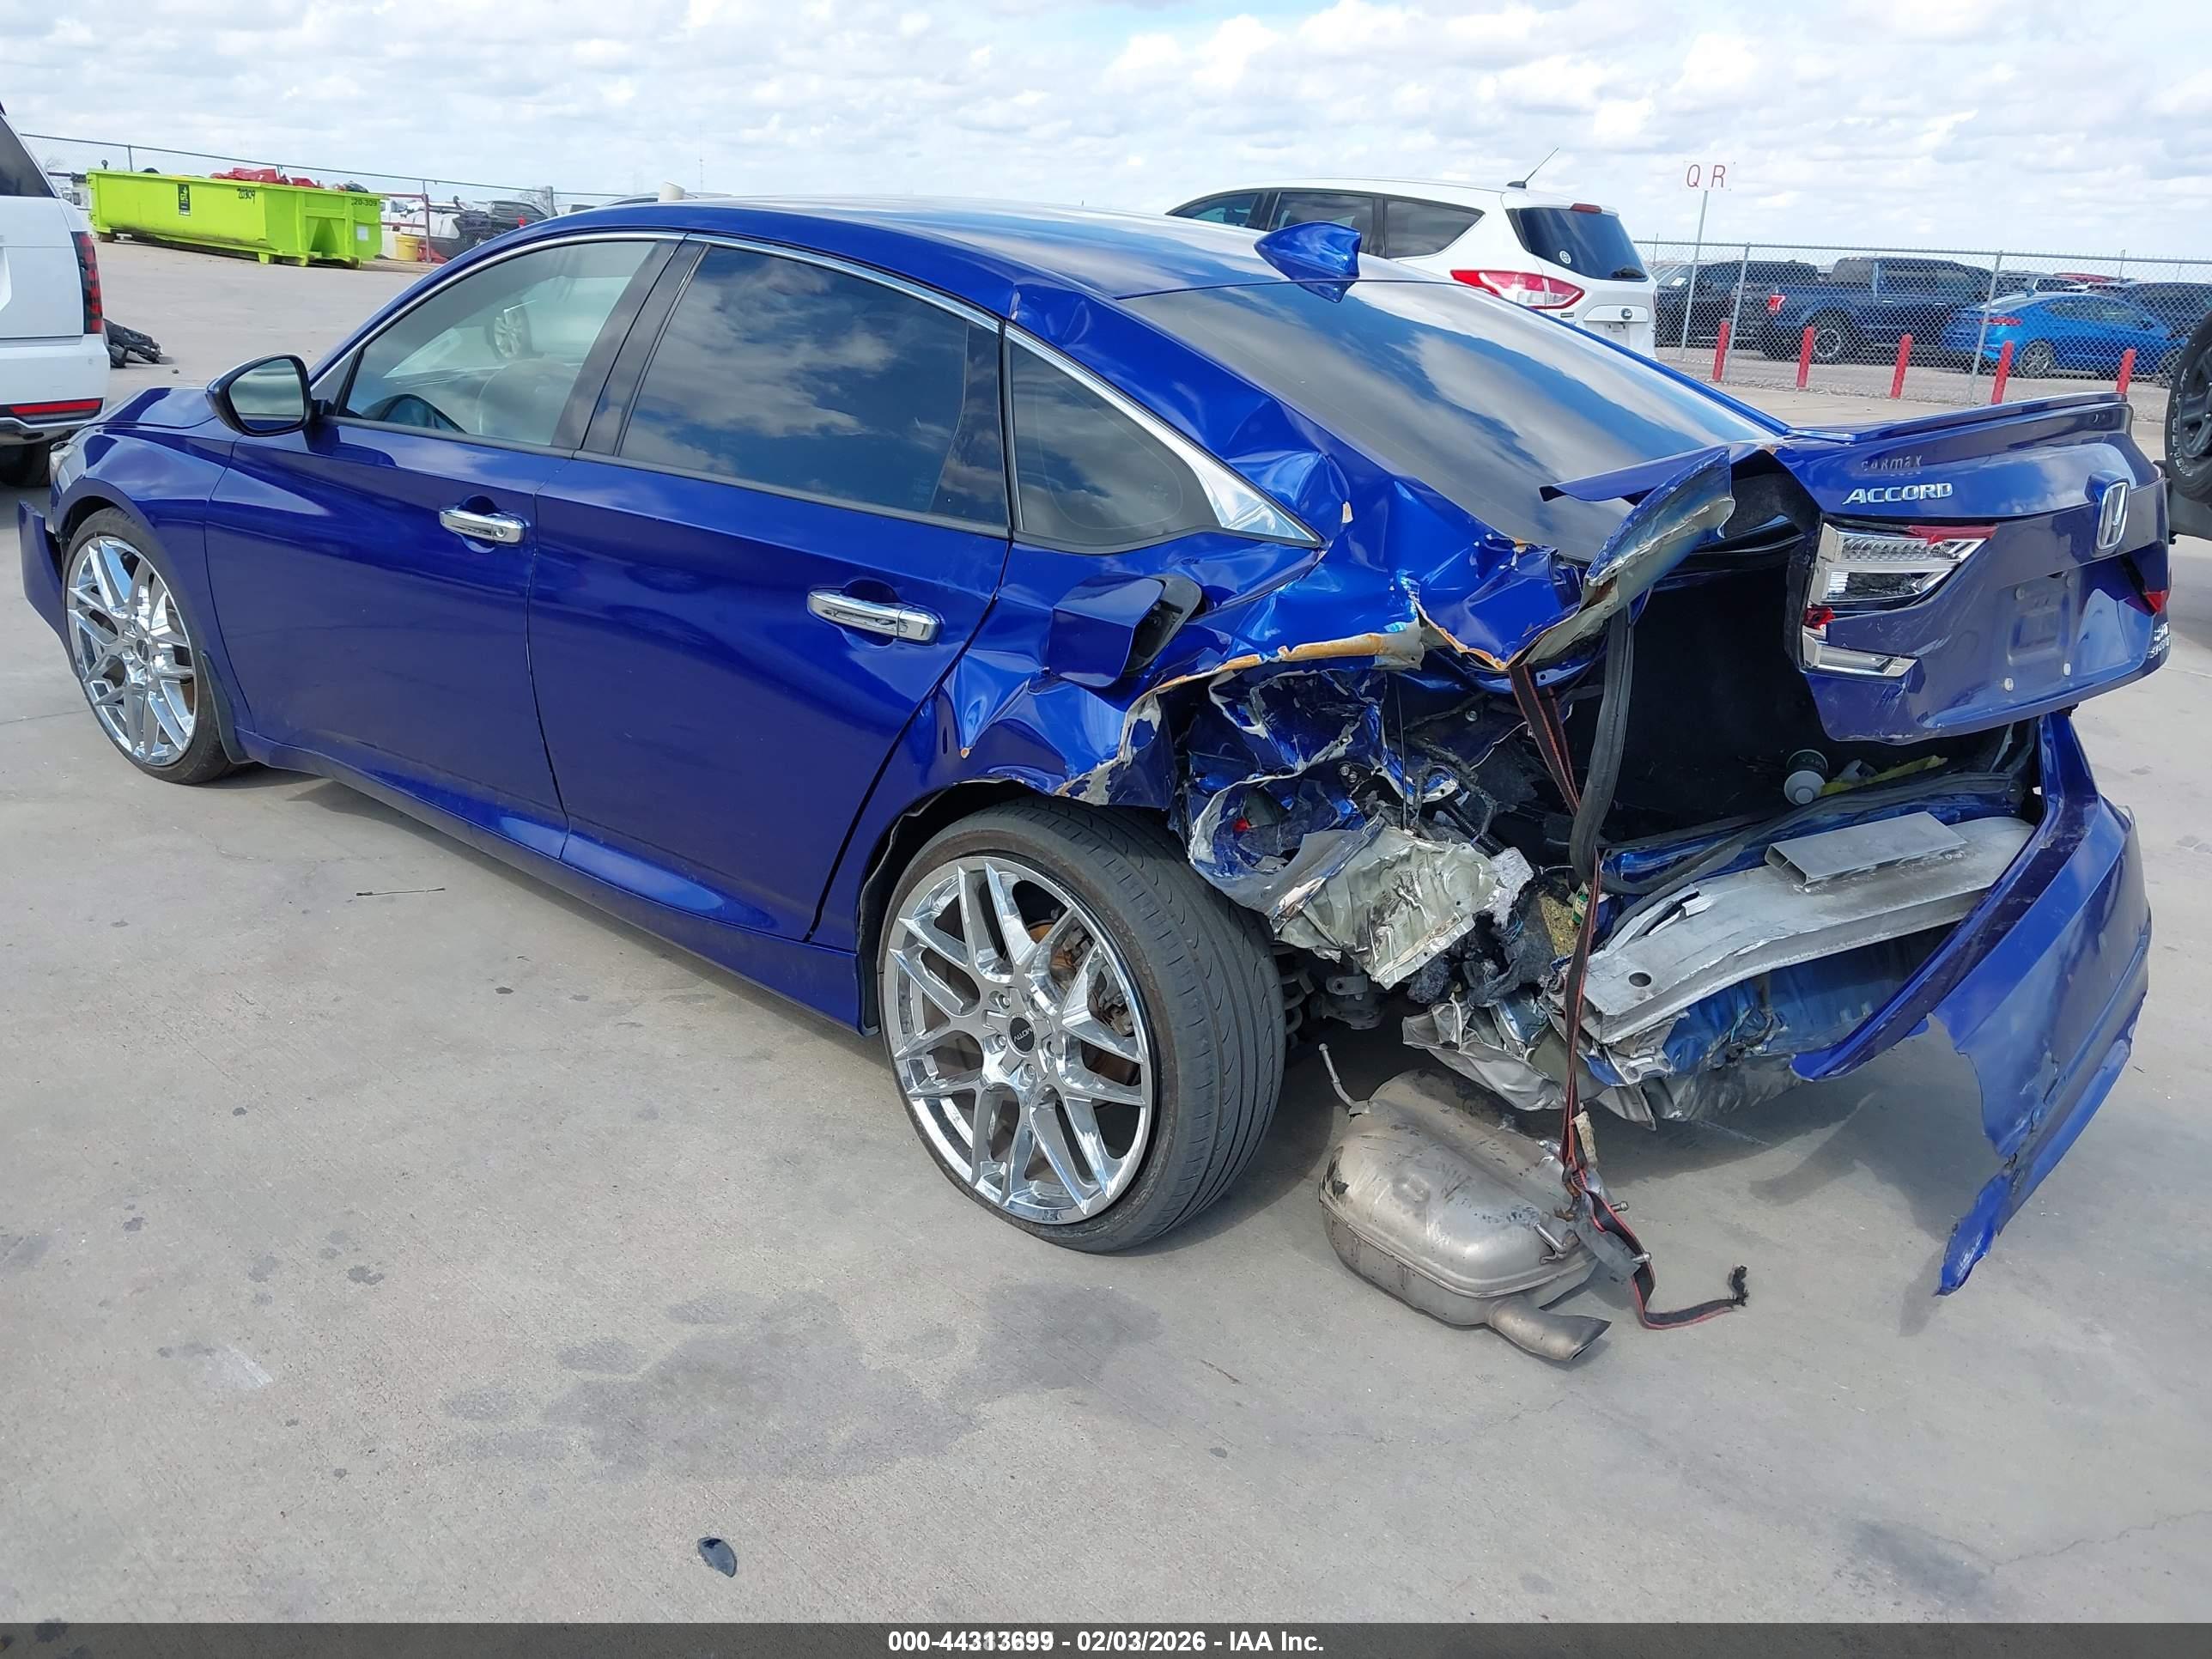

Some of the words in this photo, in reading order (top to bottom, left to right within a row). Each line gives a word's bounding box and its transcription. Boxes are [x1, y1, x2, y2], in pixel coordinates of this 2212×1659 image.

[1686, 164, 1700, 188] Q
[1711, 164, 1726, 188] R
[1841, 482, 1954, 505] ACCORD
